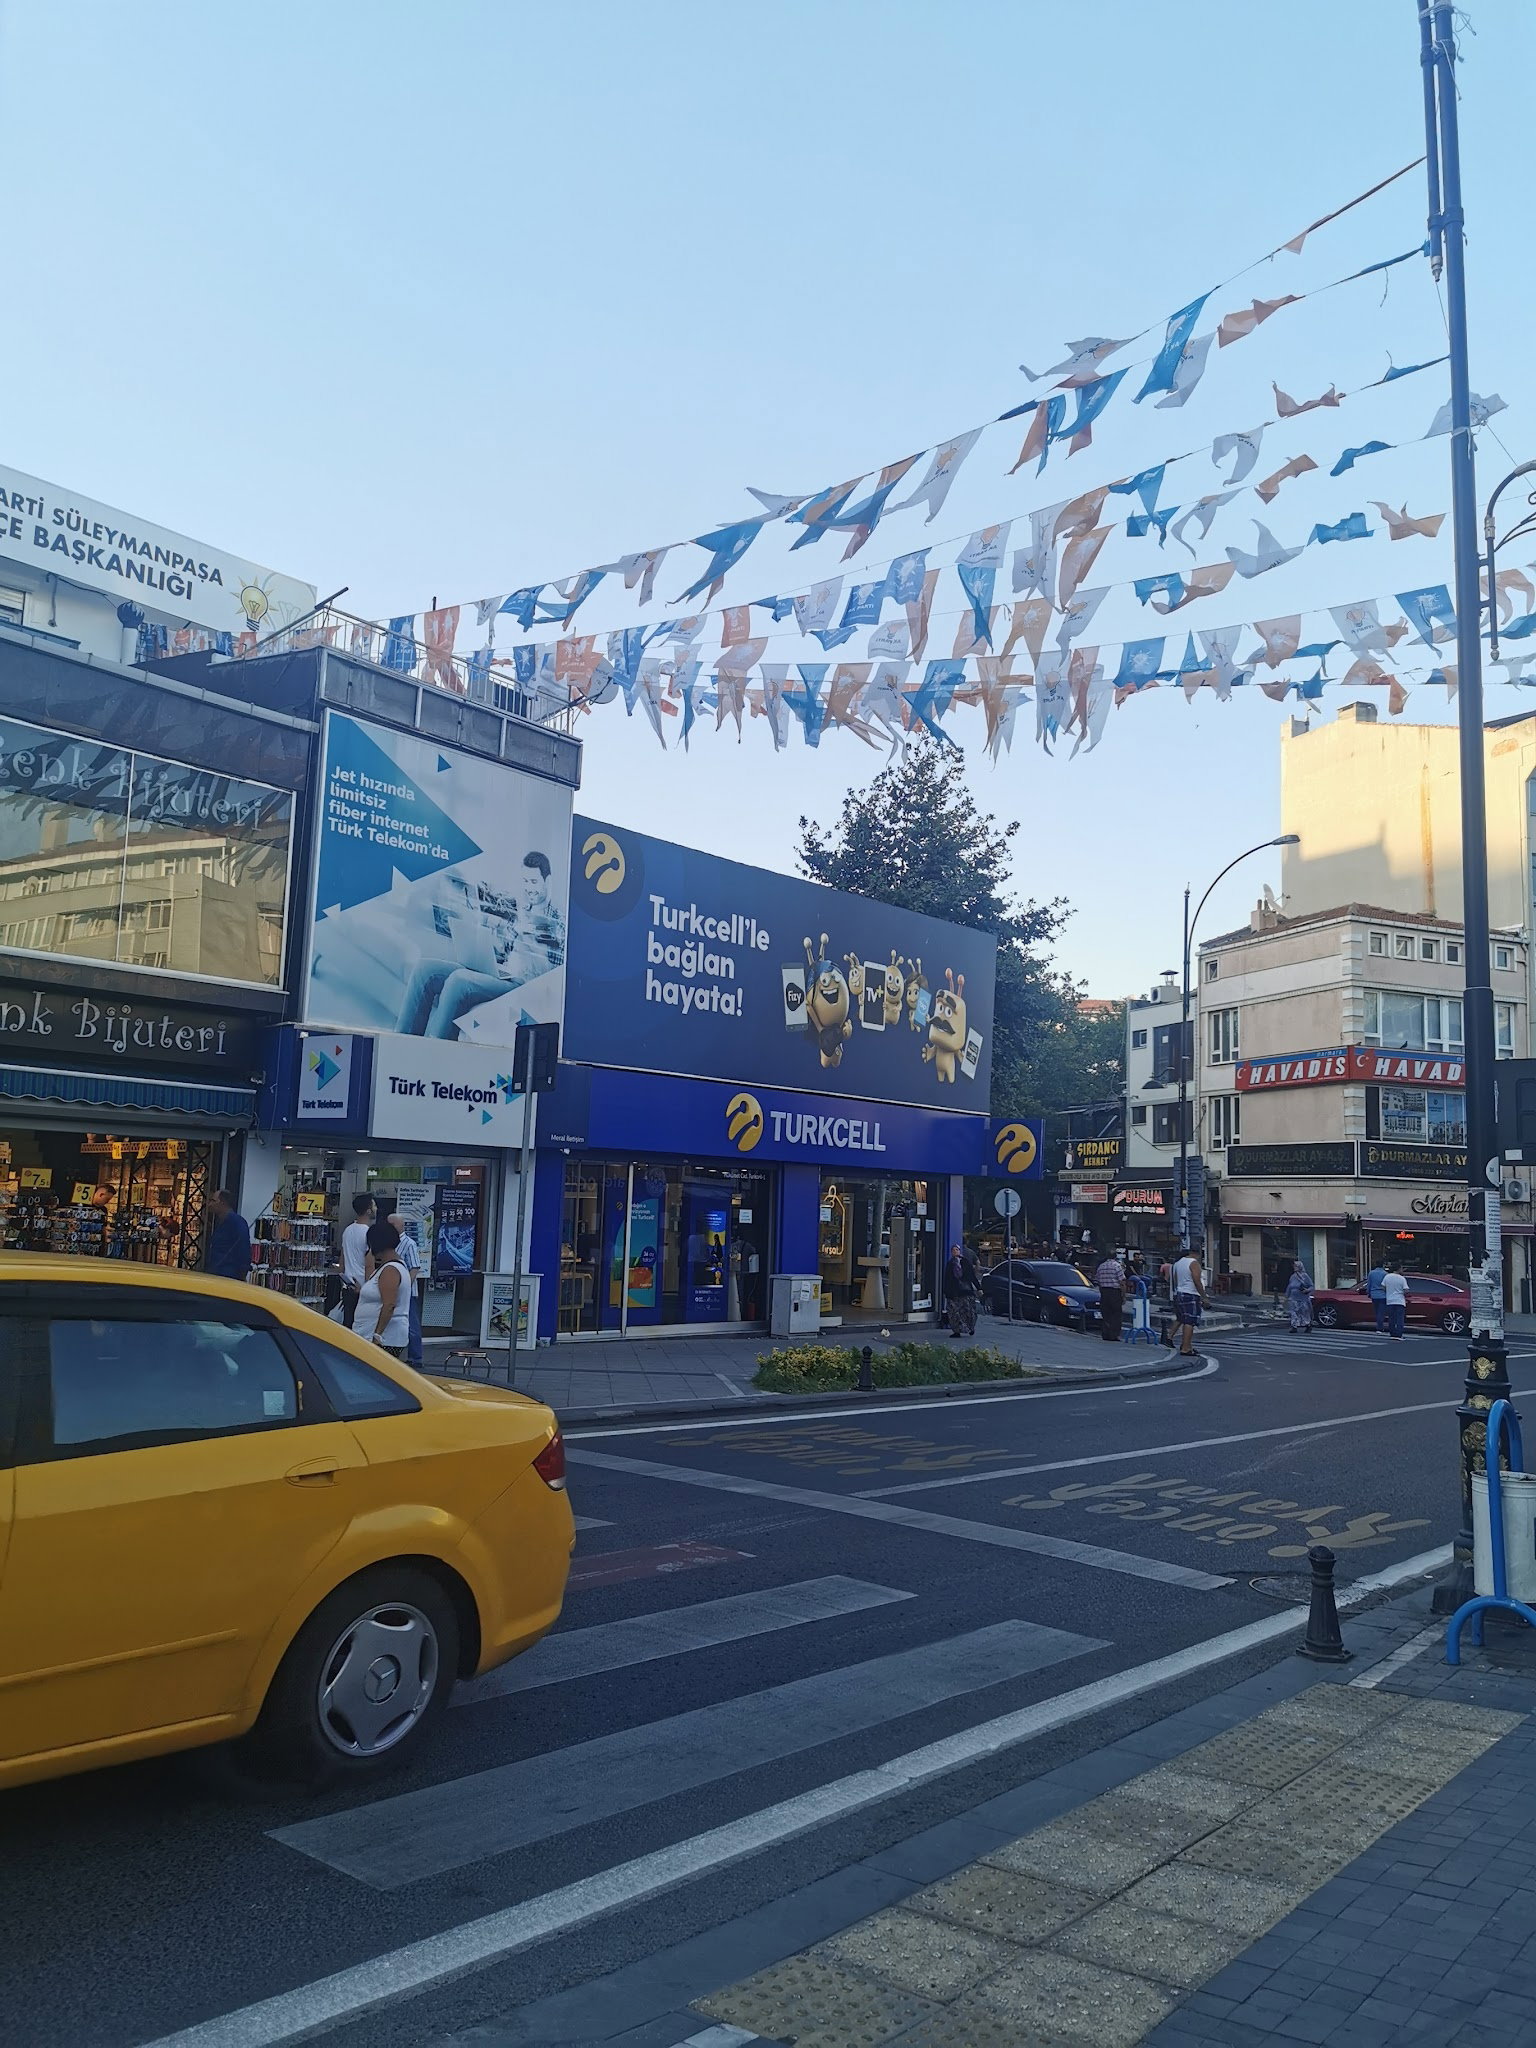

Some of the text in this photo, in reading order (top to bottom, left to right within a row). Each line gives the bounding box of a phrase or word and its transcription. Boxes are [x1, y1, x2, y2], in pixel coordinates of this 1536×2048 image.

[34, 526, 193, 600] BAŞKANLIĞI
[52, 508, 223, 587] SÜLEYMANPAŞA
[330, 782, 387, 809] limitsiz
[331, 765, 415, 800] Jet hızında
[328, 817, 450, 859] Türk Telekom'da
[329, 799, 430, 837] fiber internet
[649, 894, 770, 952] Turkcell'le
[647, 931, 735, 980] bağlan
[645, 969, 744, 1018] hayata!
[71, 997, 227, 1056] Bijuteri
[389, 1076, 498, 1104] Türk Telekom
[1374, 1056, 1462, 1082] HAVAD
[770, 1110, 886, 1153] TURKCELL
[1085, 1500, 1279, 1546] önce
